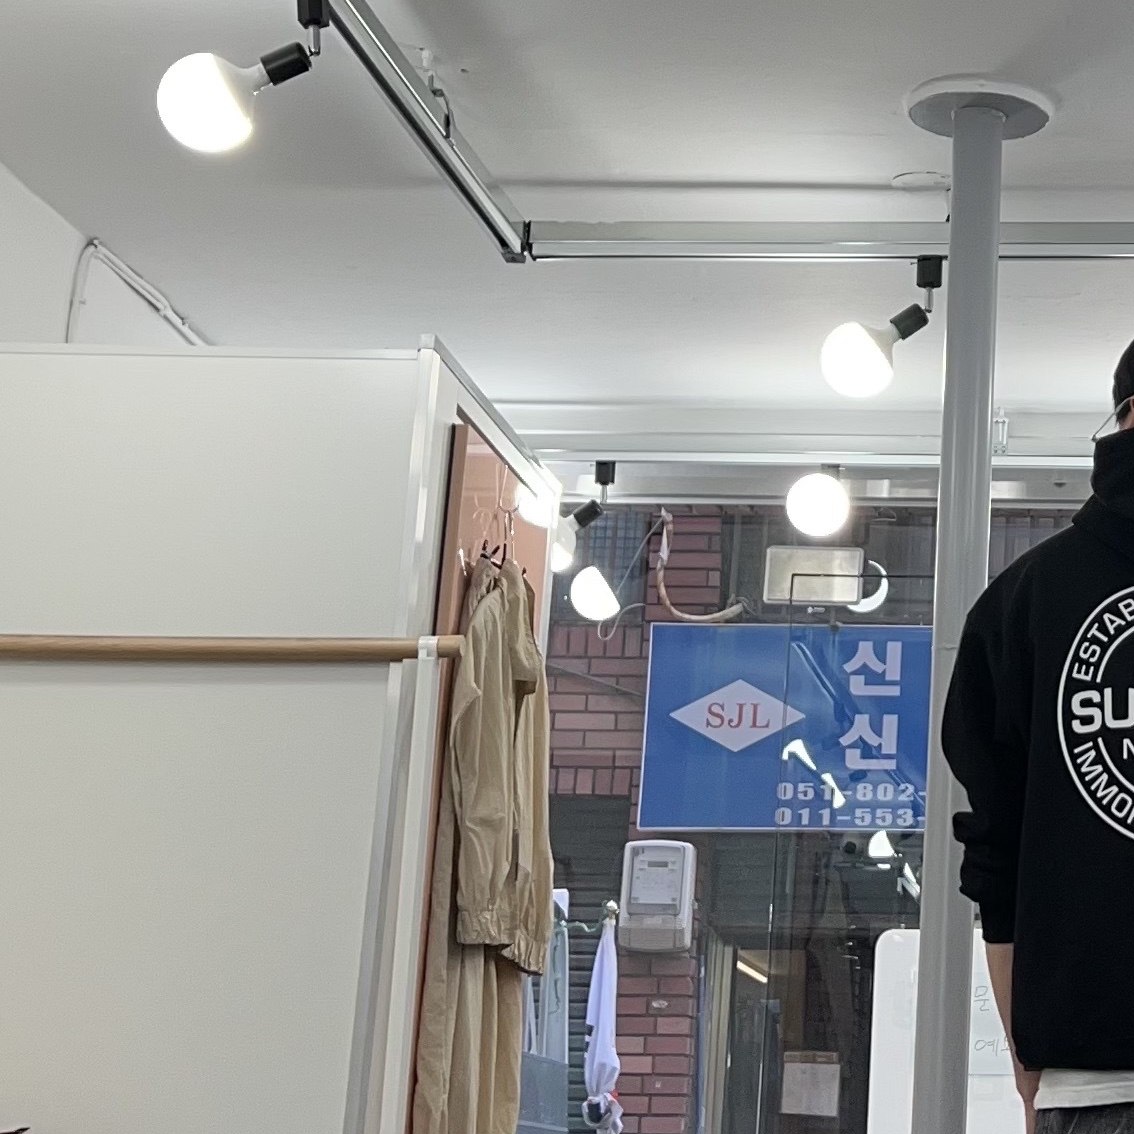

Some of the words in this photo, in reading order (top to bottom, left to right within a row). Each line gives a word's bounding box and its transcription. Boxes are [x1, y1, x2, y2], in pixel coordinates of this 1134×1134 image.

[842, 640, 902, 697] 신
[705, 702, 771, 729] SJL
[839, 713, 898, 770] 신
